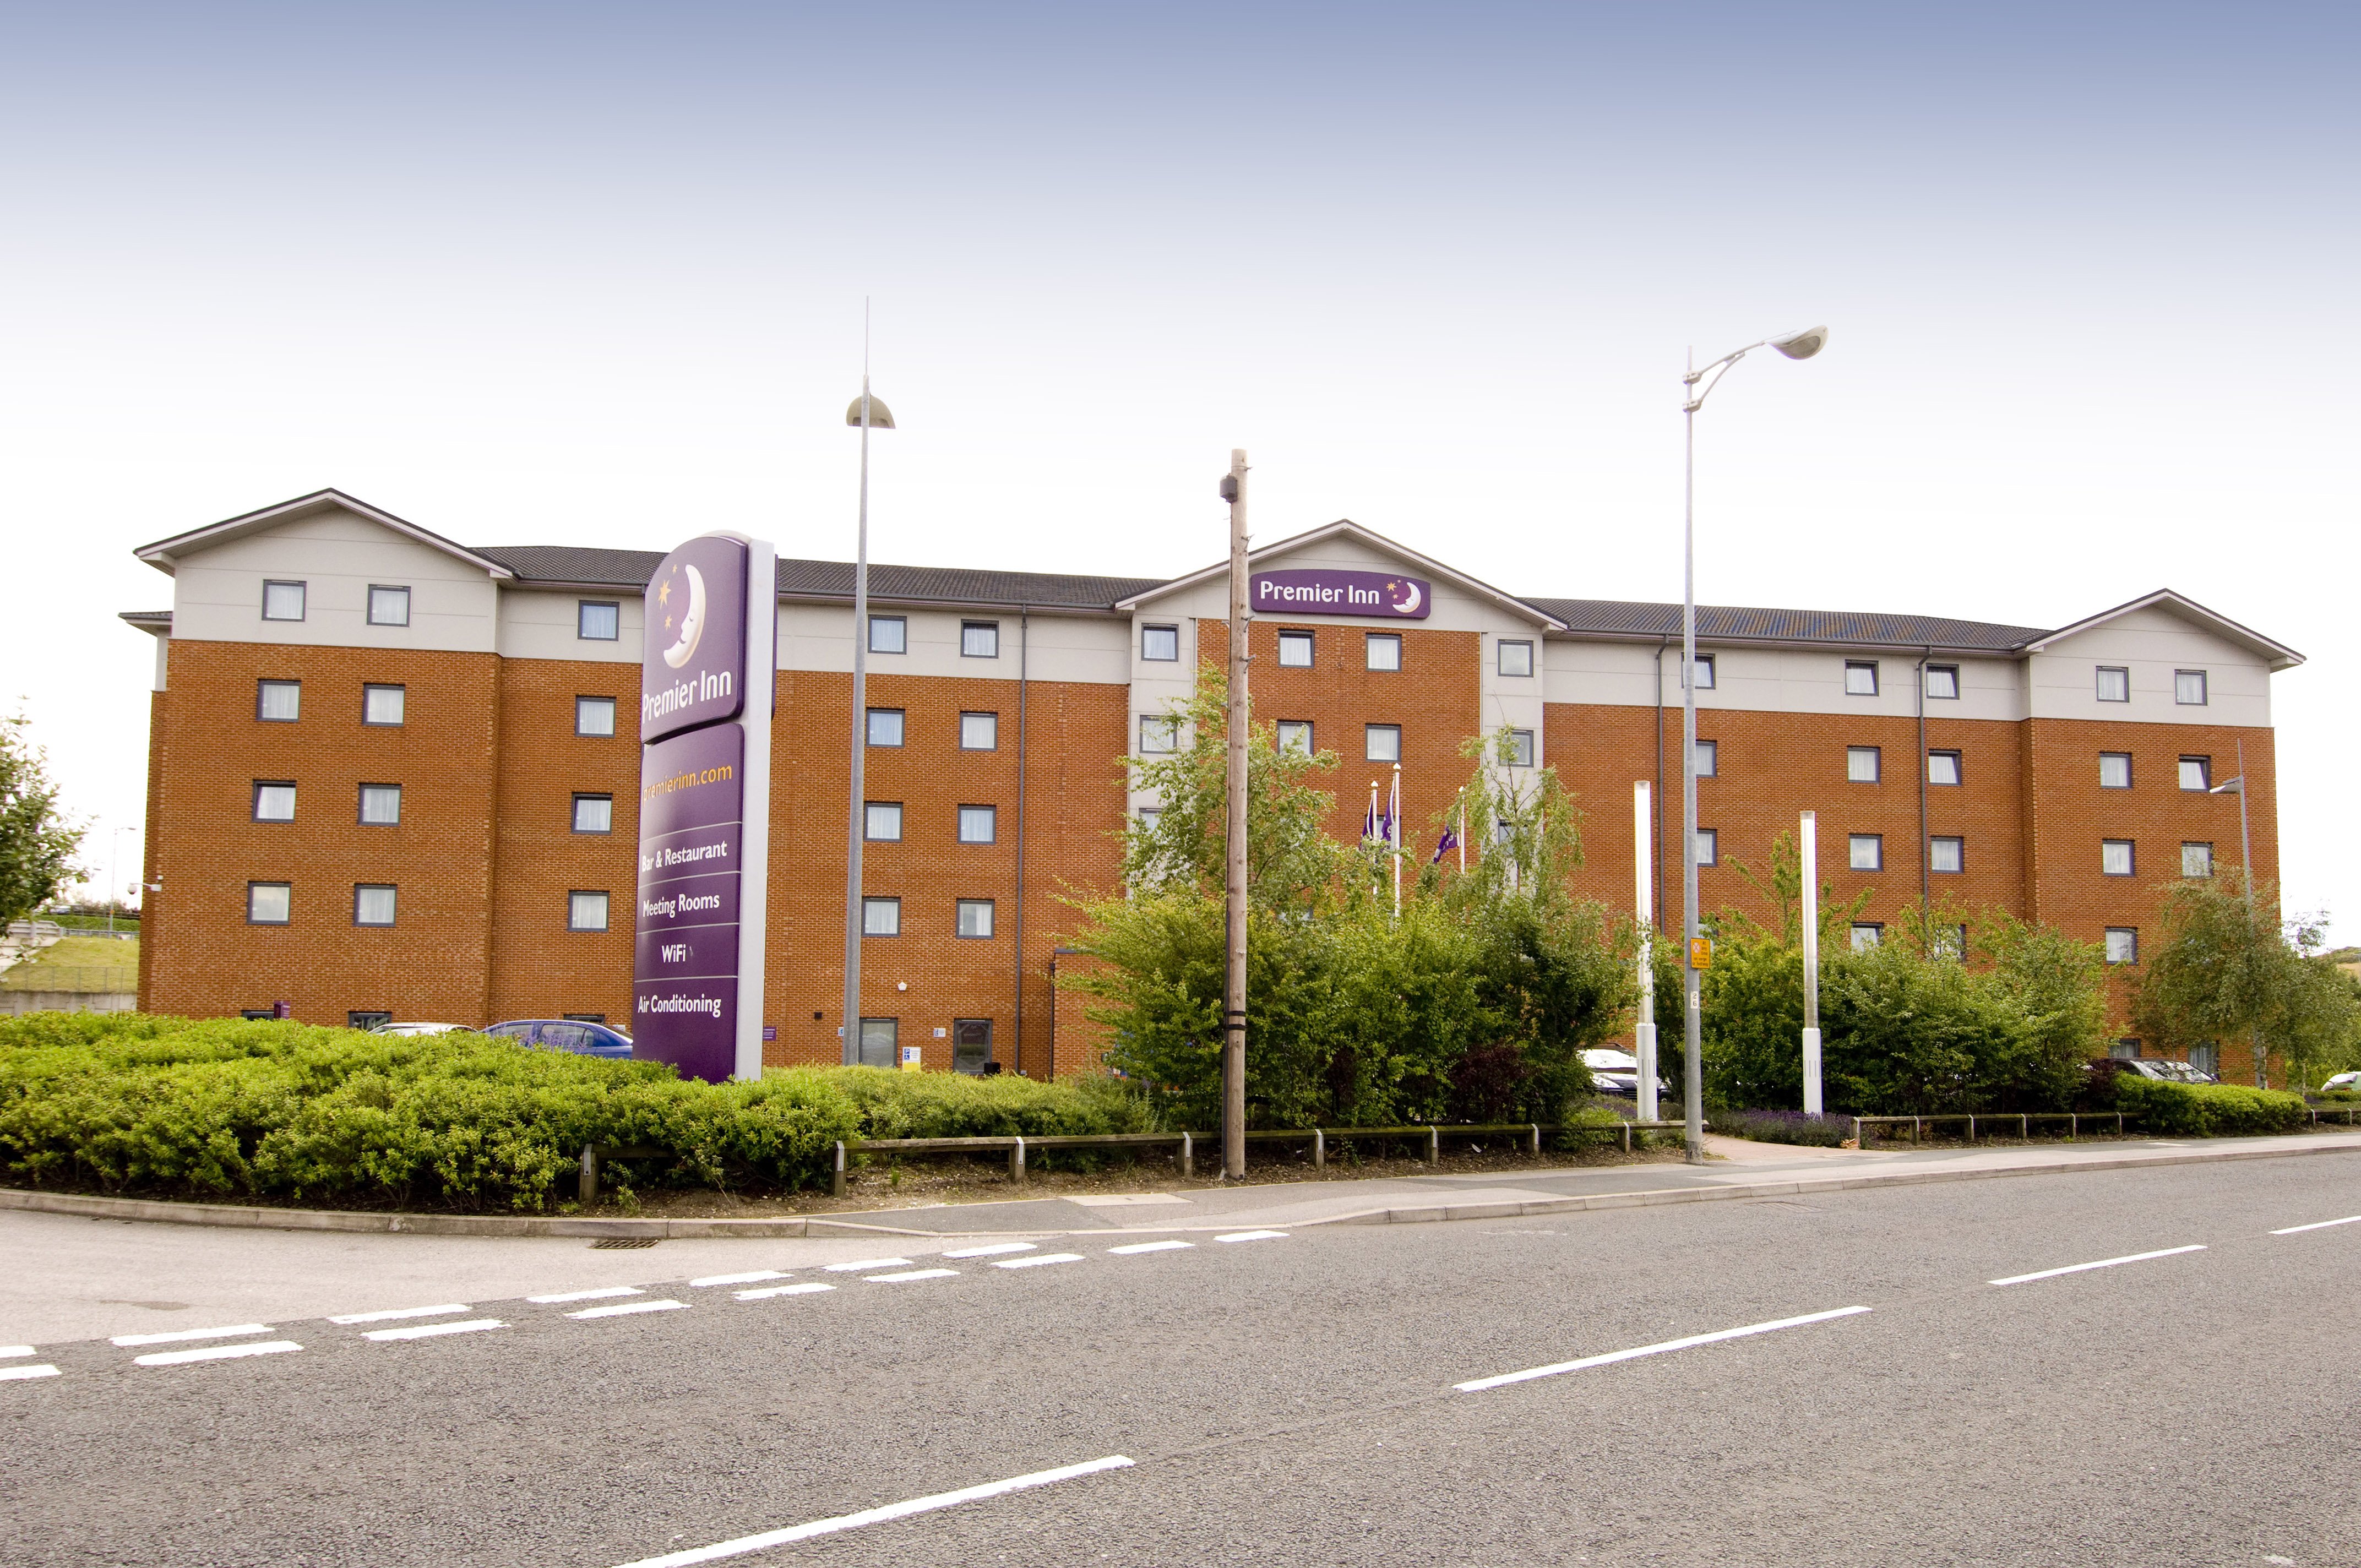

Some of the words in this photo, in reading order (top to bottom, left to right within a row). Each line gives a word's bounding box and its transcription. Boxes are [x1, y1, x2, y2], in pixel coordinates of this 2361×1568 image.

[1260, 581, 1343, 603] Premier
[1348, 585, 1380, 605] Inn
[643, 679, 698, 724] Premier
[700, 670, 732, 702] Inn
[643, 765, 732, 808] premierinn.com
[641, 855, 654, 872] Bar
[656, 851, 662, 868] &
[665, 840, 727, 867] Restaurant
[643, 896, 676, 918] Meeting
[678, 894, 720, 912] Rooms
[661, 944, 686, 963] WiFi
[638, 995, 649, 1013] Air
[651, 994, 721, 1017] Conditioning
